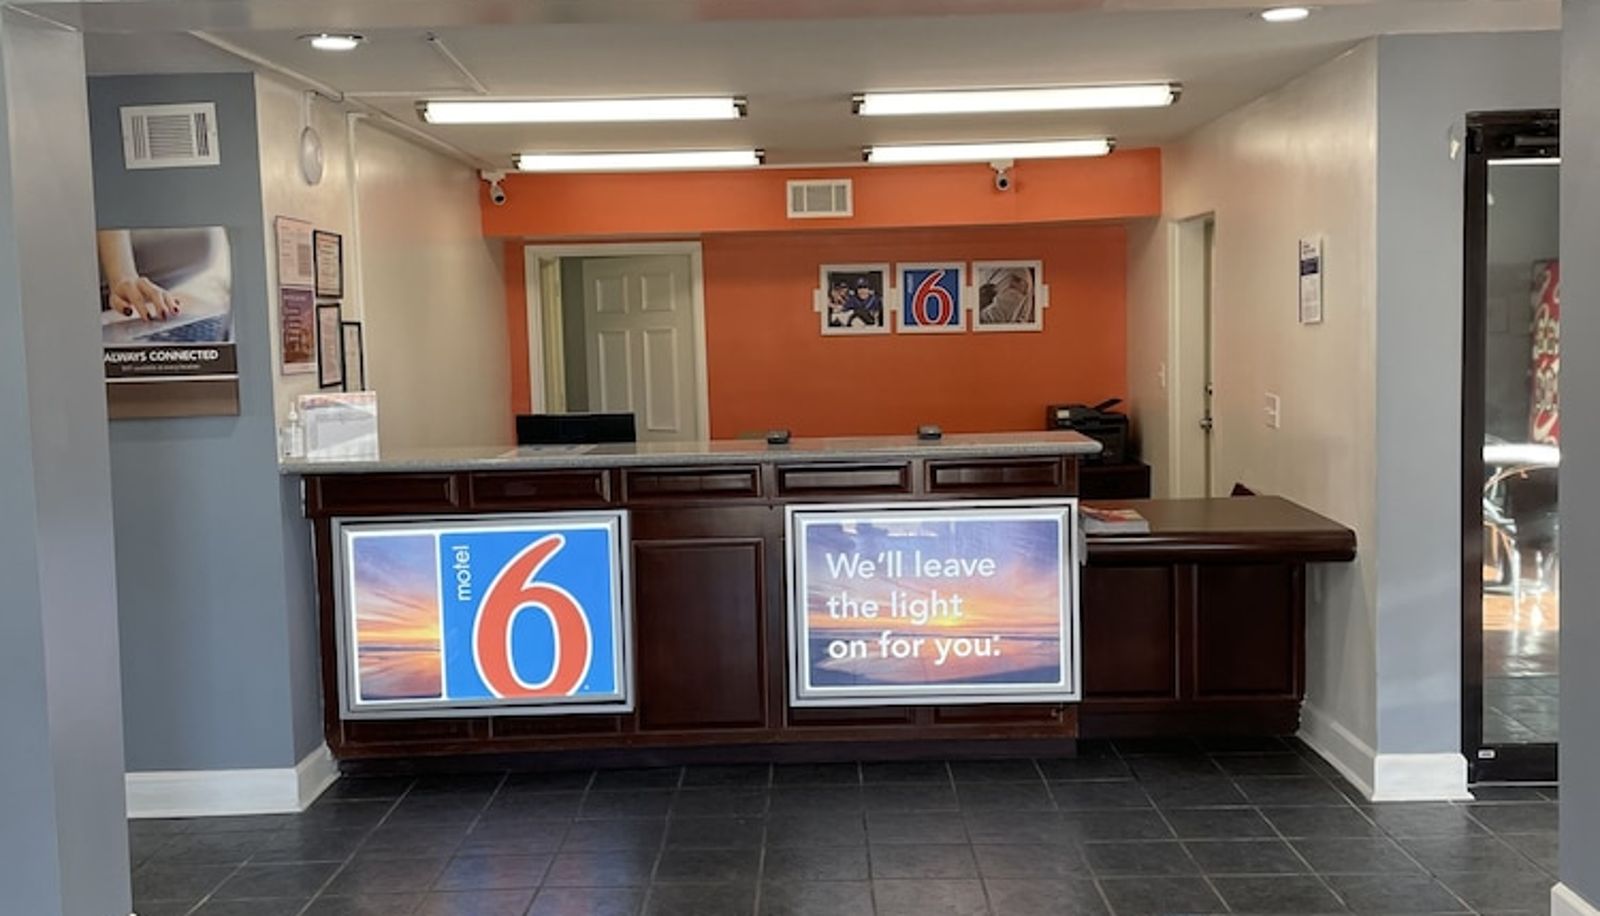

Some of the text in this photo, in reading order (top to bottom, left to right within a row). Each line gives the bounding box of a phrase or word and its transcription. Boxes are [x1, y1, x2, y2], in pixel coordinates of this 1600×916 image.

[912, 268, 954, 326] 6
[104, 349, 219, 363] ALWAYS CONNECTED
[451, 545, 472, 601] motel
[826, 550, 996, 579] We'll leave
[472, 533, 593, 698] 6
[826, 590, 964, 625] the light
[828, 638, 867, 659] on
[879, 630, 924, 658] for
